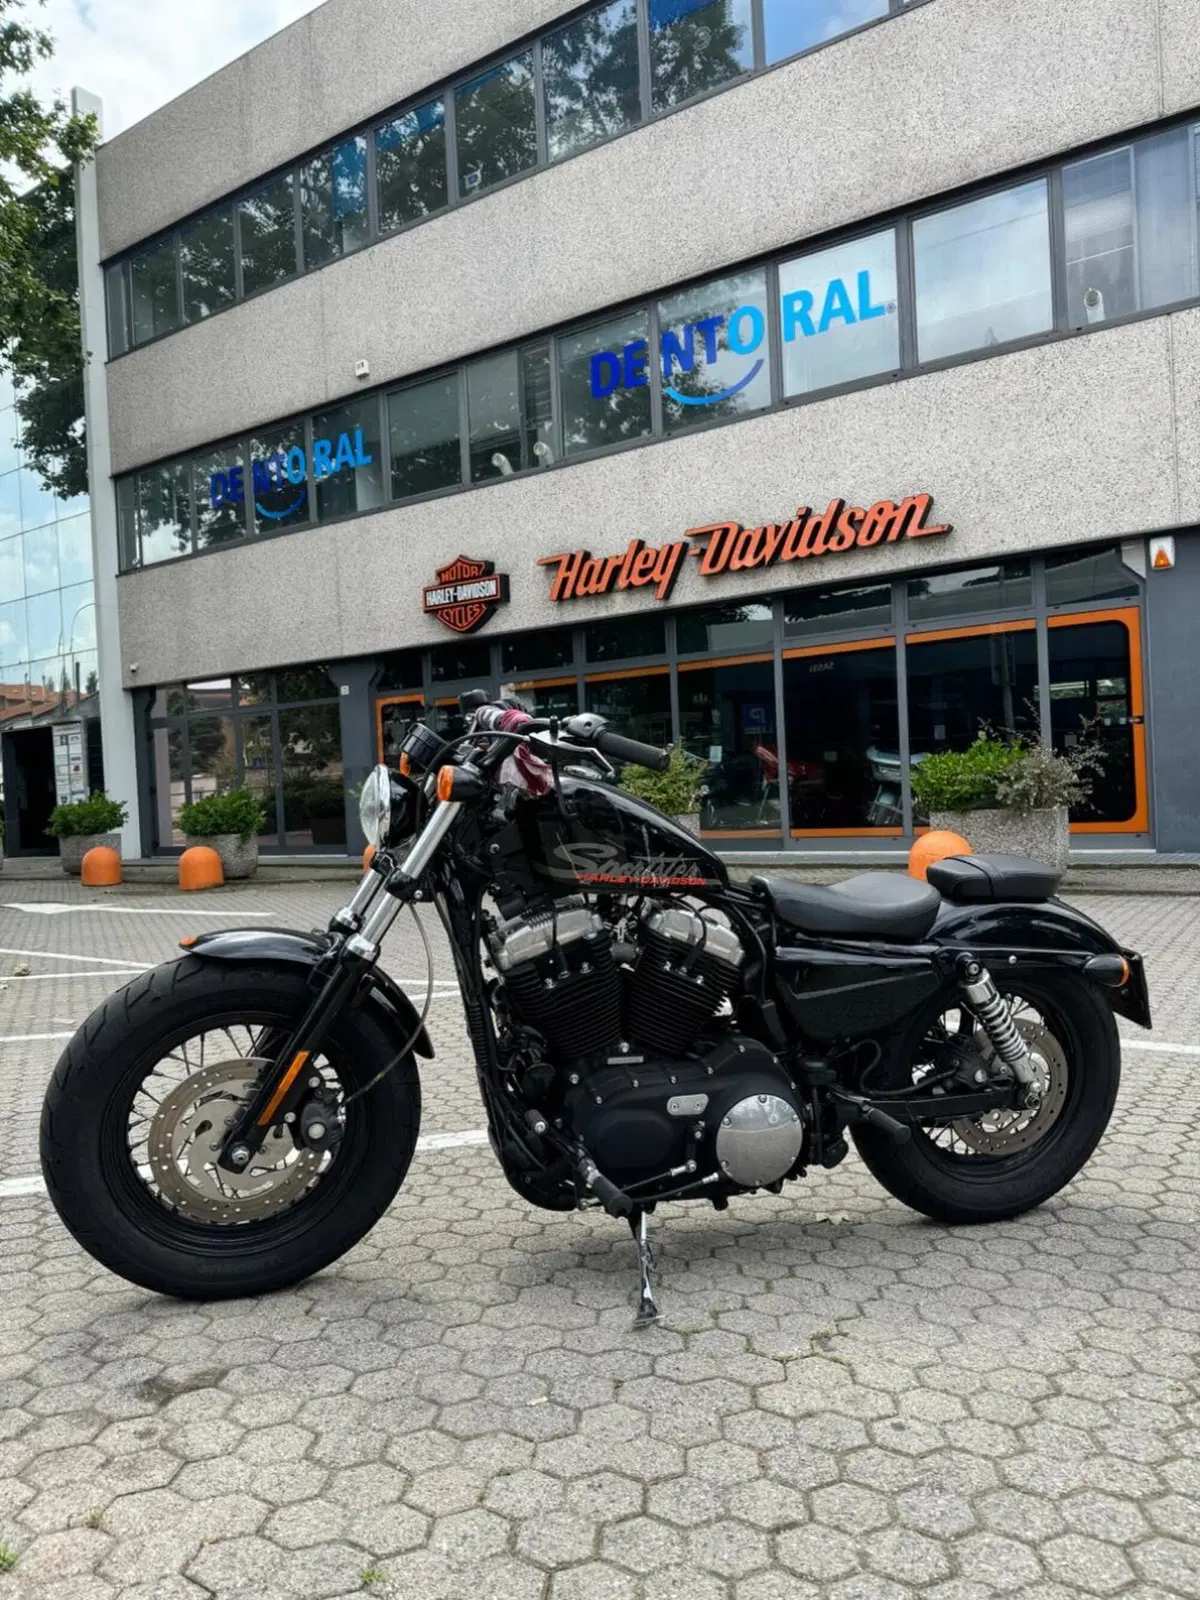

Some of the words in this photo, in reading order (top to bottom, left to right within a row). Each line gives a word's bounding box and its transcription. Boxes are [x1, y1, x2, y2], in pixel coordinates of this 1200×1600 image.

[537, 493, 953, 601] Harley-Davidson
[441, 561, 480, 583] MOTOR
[442, 603, 480, 628] CYCLES
[575, 872, 708, 887] HARLEY-DAVIDSON
